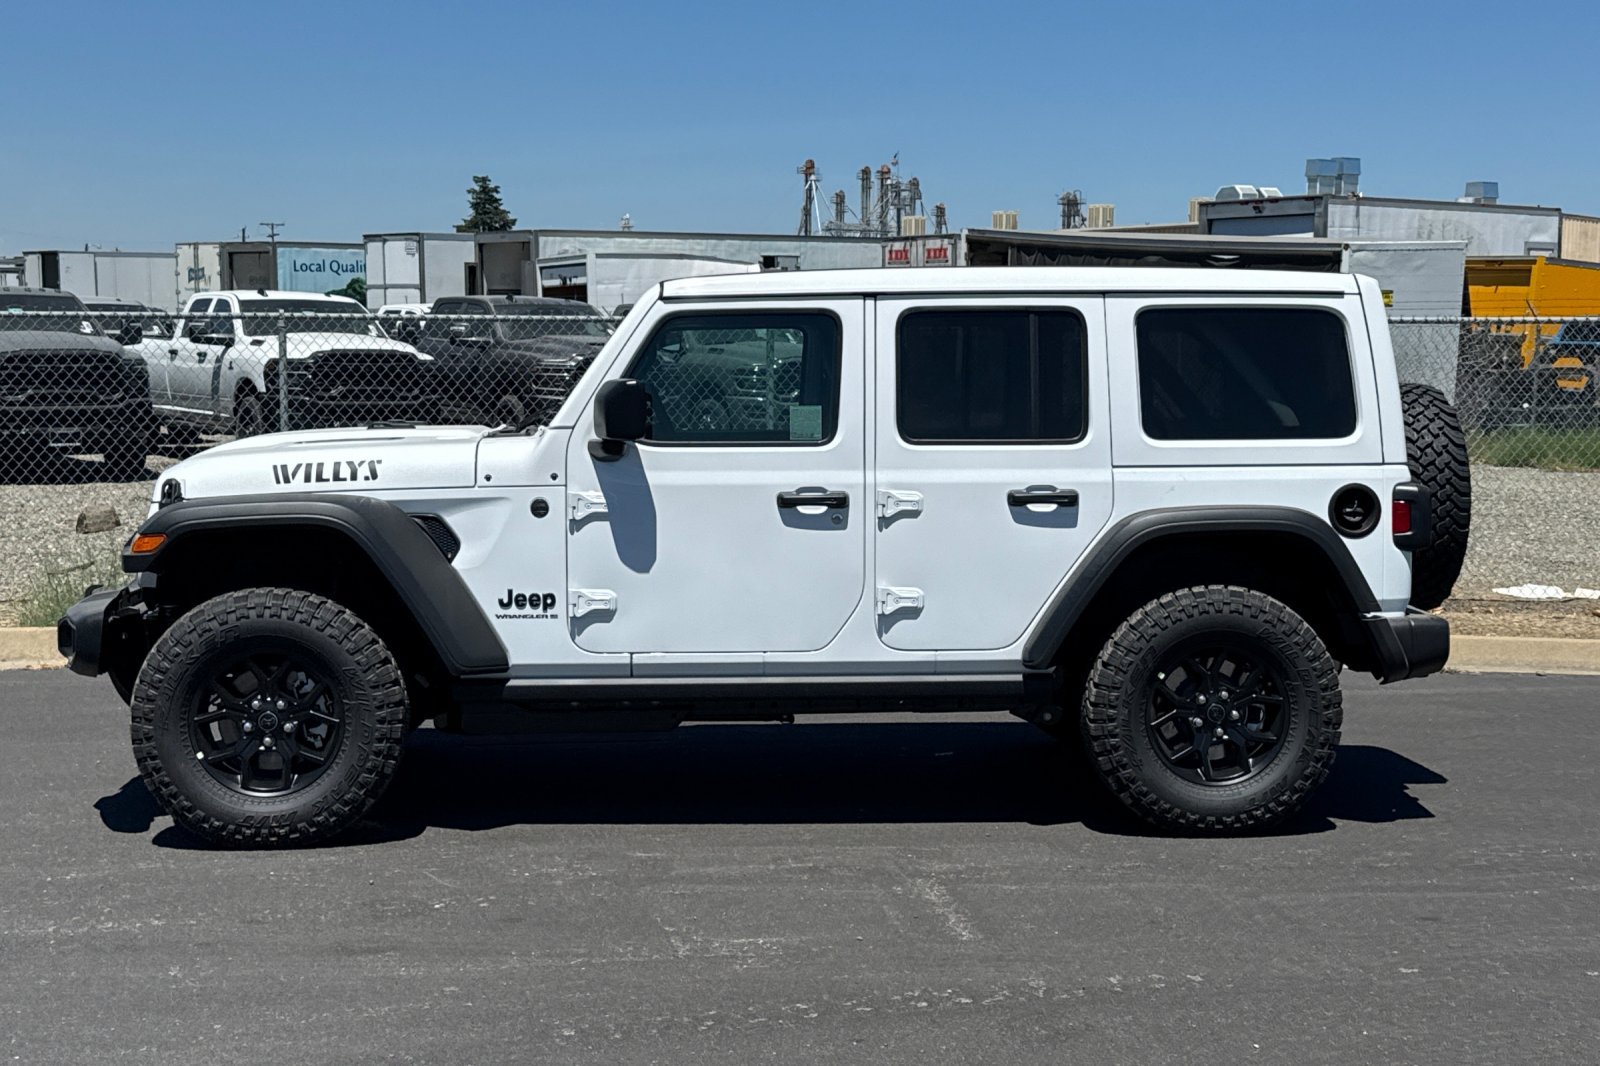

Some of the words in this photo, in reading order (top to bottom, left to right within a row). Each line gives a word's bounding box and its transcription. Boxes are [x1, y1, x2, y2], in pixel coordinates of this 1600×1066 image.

[293, 259, 326, 273] Local
[273, 459, 382, 484] WILLYS
[498, 588, 556, 613] Jeep
